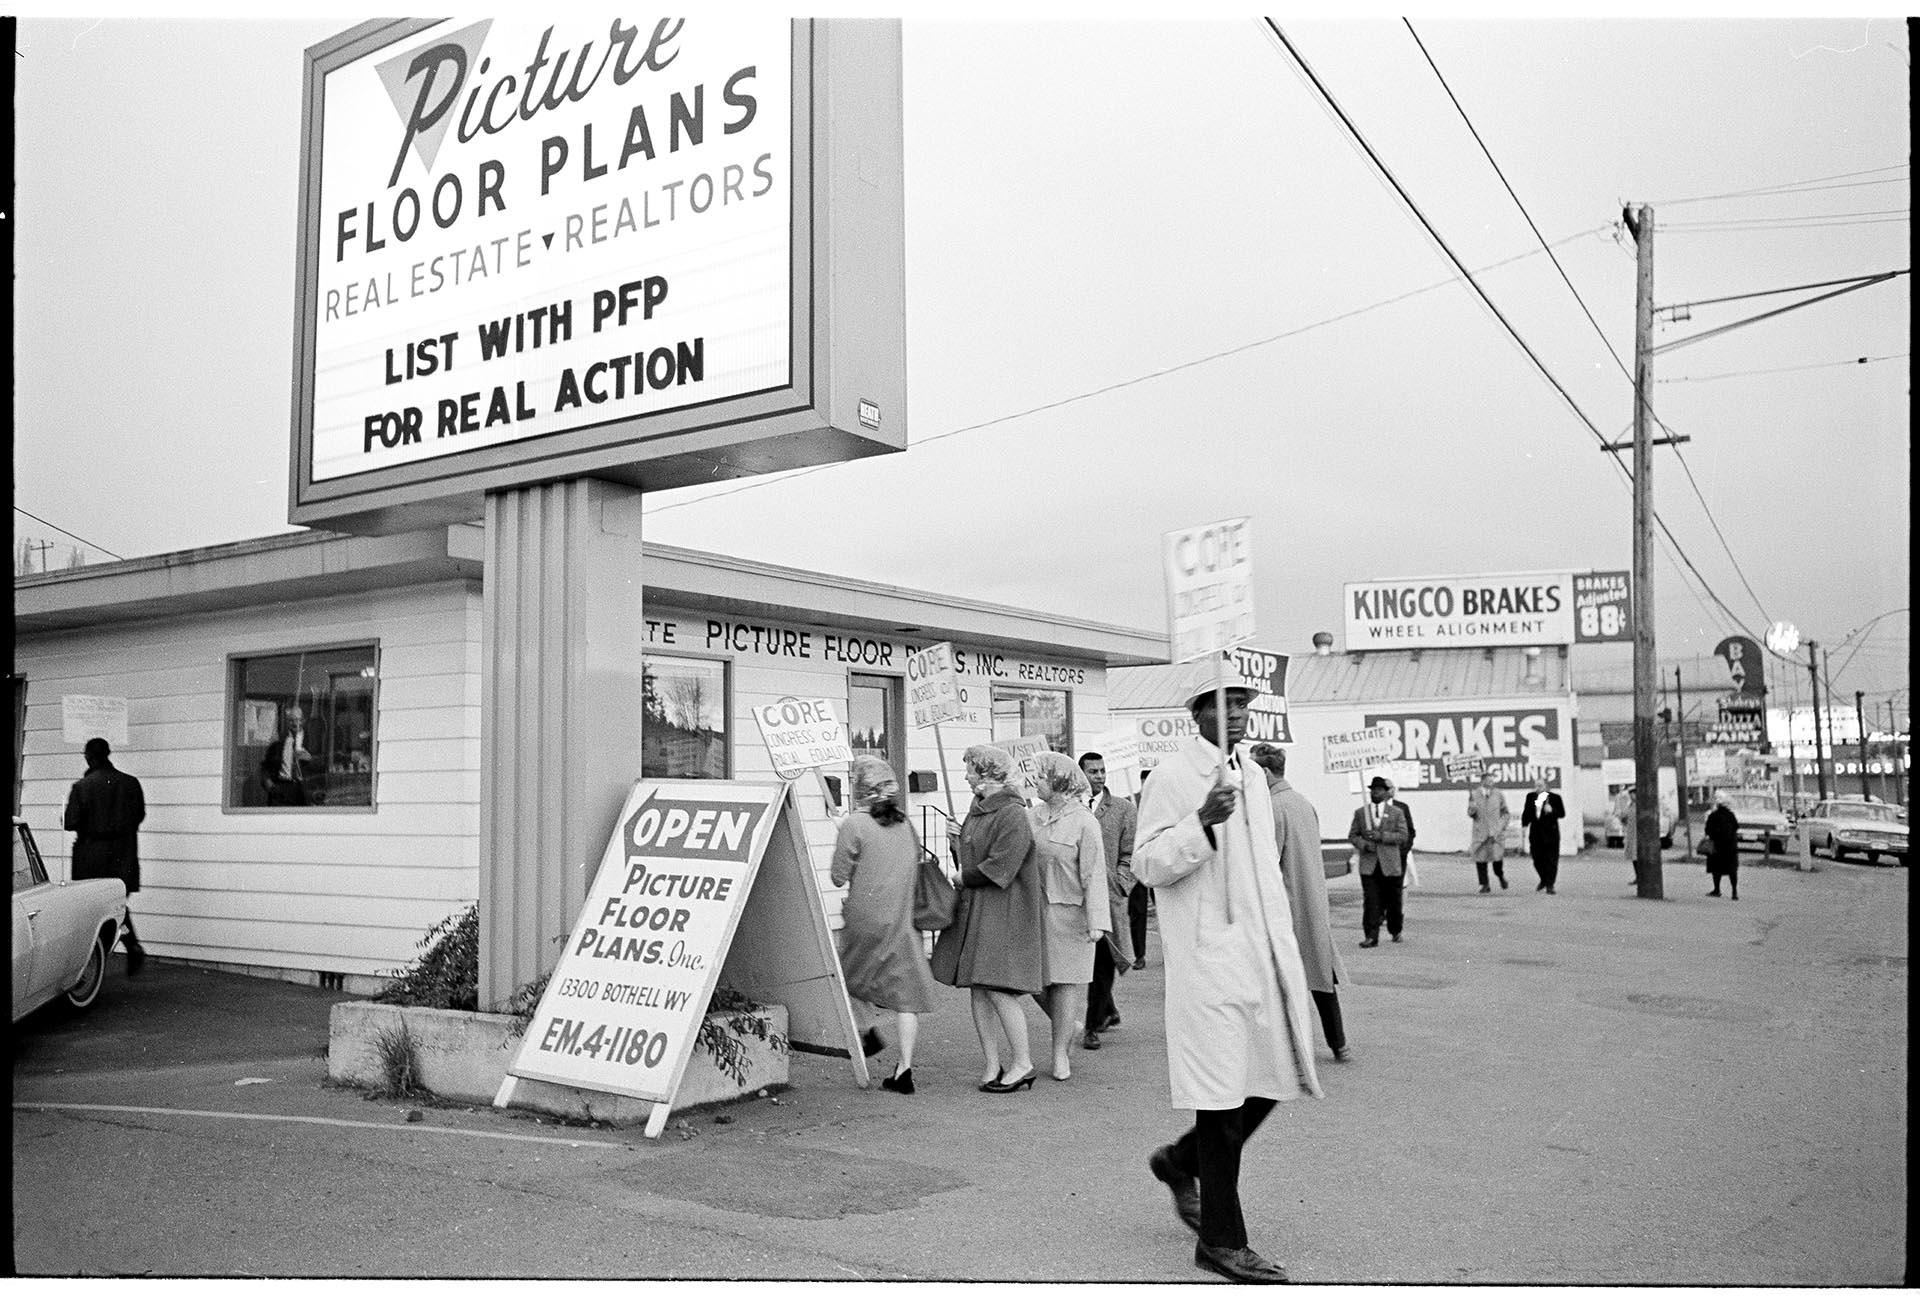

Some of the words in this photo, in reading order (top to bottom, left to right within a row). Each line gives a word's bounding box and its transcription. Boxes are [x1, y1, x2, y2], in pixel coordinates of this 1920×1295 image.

[387, 18, 686, 189] Picture
[336, 159, 507, 263] FLOOR
[540, 65, 758, 196] PLANS
[325, 272, 400, 322] REAL
[410, 228, 532, 298] ESTATE
[565, 152, 774, 252] REALTORS
[385, 332, 458, 385] LIST
[478, 300, 573, 361] WITH
[593, 275, 669, 333] PFP
[363, 410, 423, 453] FOR
[437, 380, 536, 438] REAL
[554, 337, 704, 413] ACTION
[1577, 576, 1625, 591] BRAKES
[1354, 586, 1454, 620] KINGCO
[1463, 585, 1561, 615] BRAKES
[1369, 624, 1425, 638] WHEEL
[1437, 620, 1545, 636] ALIGNMENT
[642, 620, 677, 644] TE
[706, 620, 811, 658] PICTURE
[825, 635, 892, 666] FLOOR
[976, 653, 1008, 677] INC.
[1019, 663, 1085, 685] REALTORS
[1231, 651, 1277, 677] STOP
[762, 700, 832, 728] CORE
[1142, 718, 1200, 736] CORE
[1375, 715, 1547, 760] BRAKES
[1705, 731, 1760, 743] PAINT
[633, 808, 751, 851] OPEN
[622, 863, 733, 902] PICTURE
[598, 897, 691, 932] FLOOR
[667, 940, 705, 971] Inc.
[558, 977, 598, 1000] 13300
[601, 983, 659, 1008] BOTHELL
[664, 990, 692, 1012] WY
